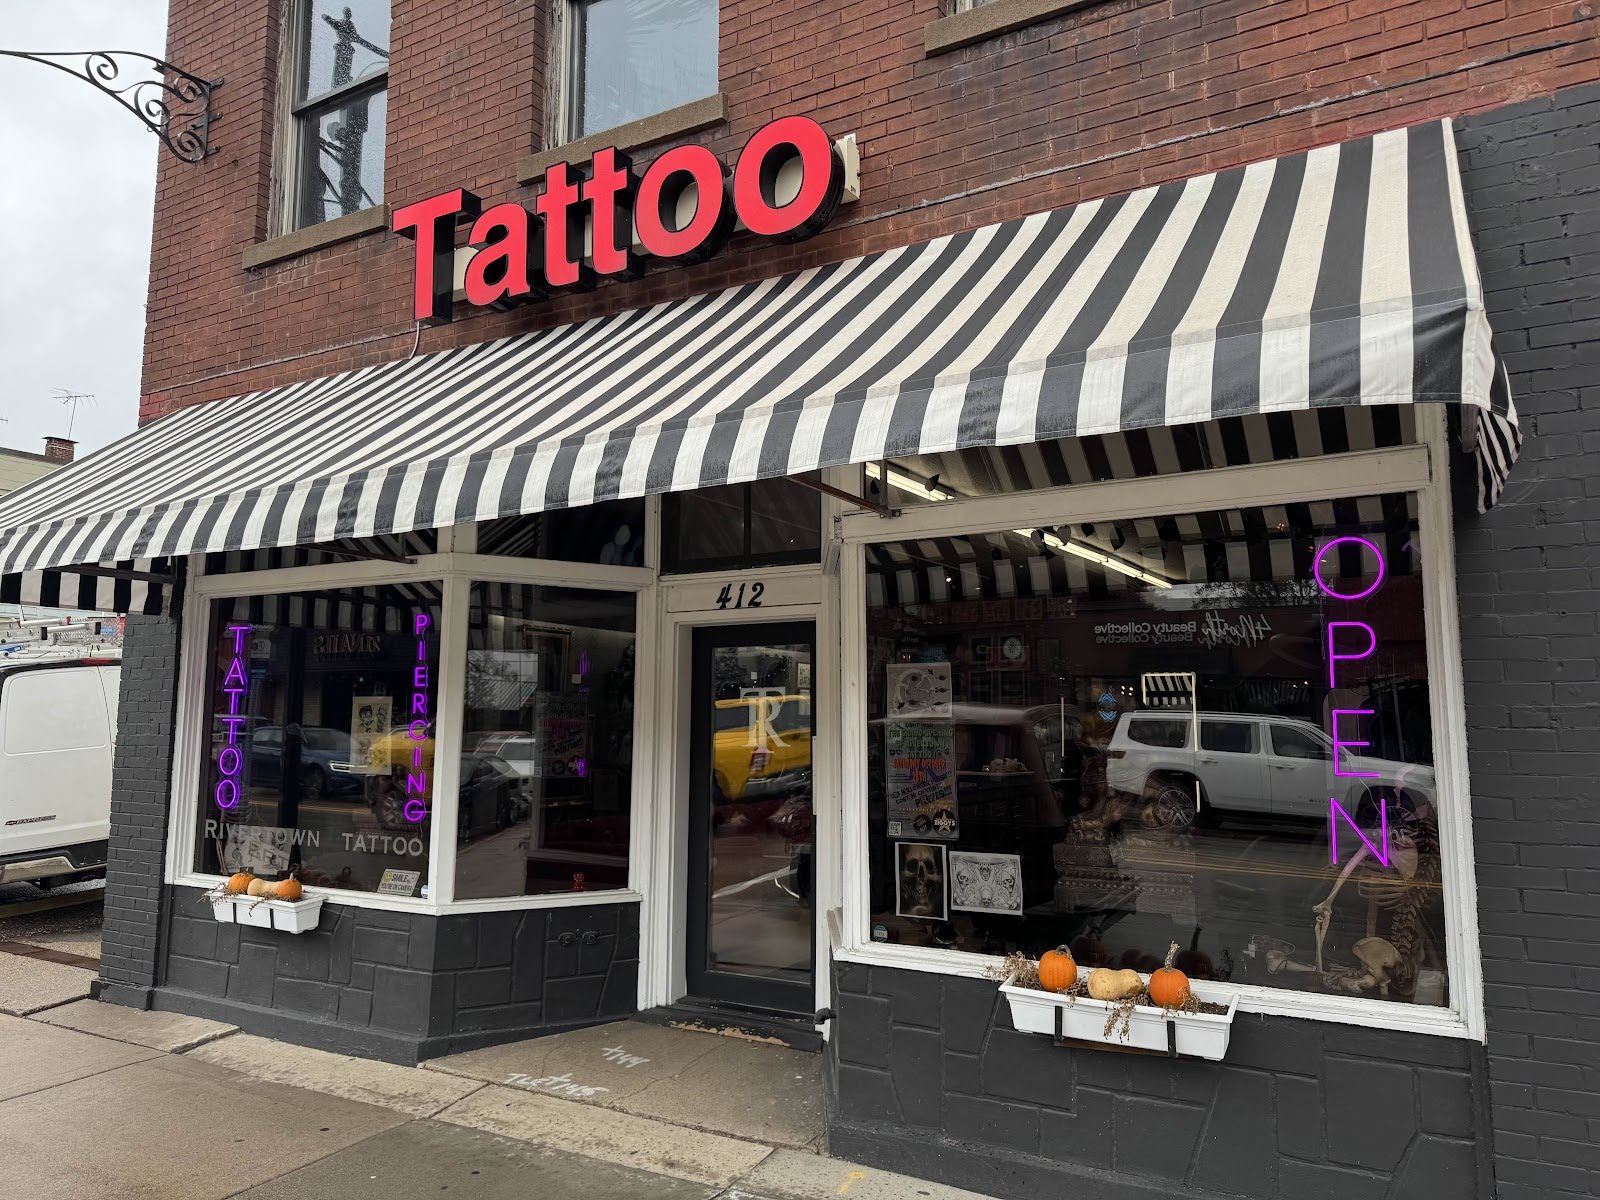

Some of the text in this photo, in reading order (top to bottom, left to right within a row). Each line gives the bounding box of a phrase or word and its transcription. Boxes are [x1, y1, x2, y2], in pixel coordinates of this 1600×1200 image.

[391, 115, 837, 322] Tattoo
[716, 582, 765, 609] 412
[216, 624, 251, 810] TATTOO
[403, 613, 430, 822] PIERCING
[1314, 536, 1388, 867] OPEN
[204, 819, 423, 857] RIVERTOWN TATTOO
